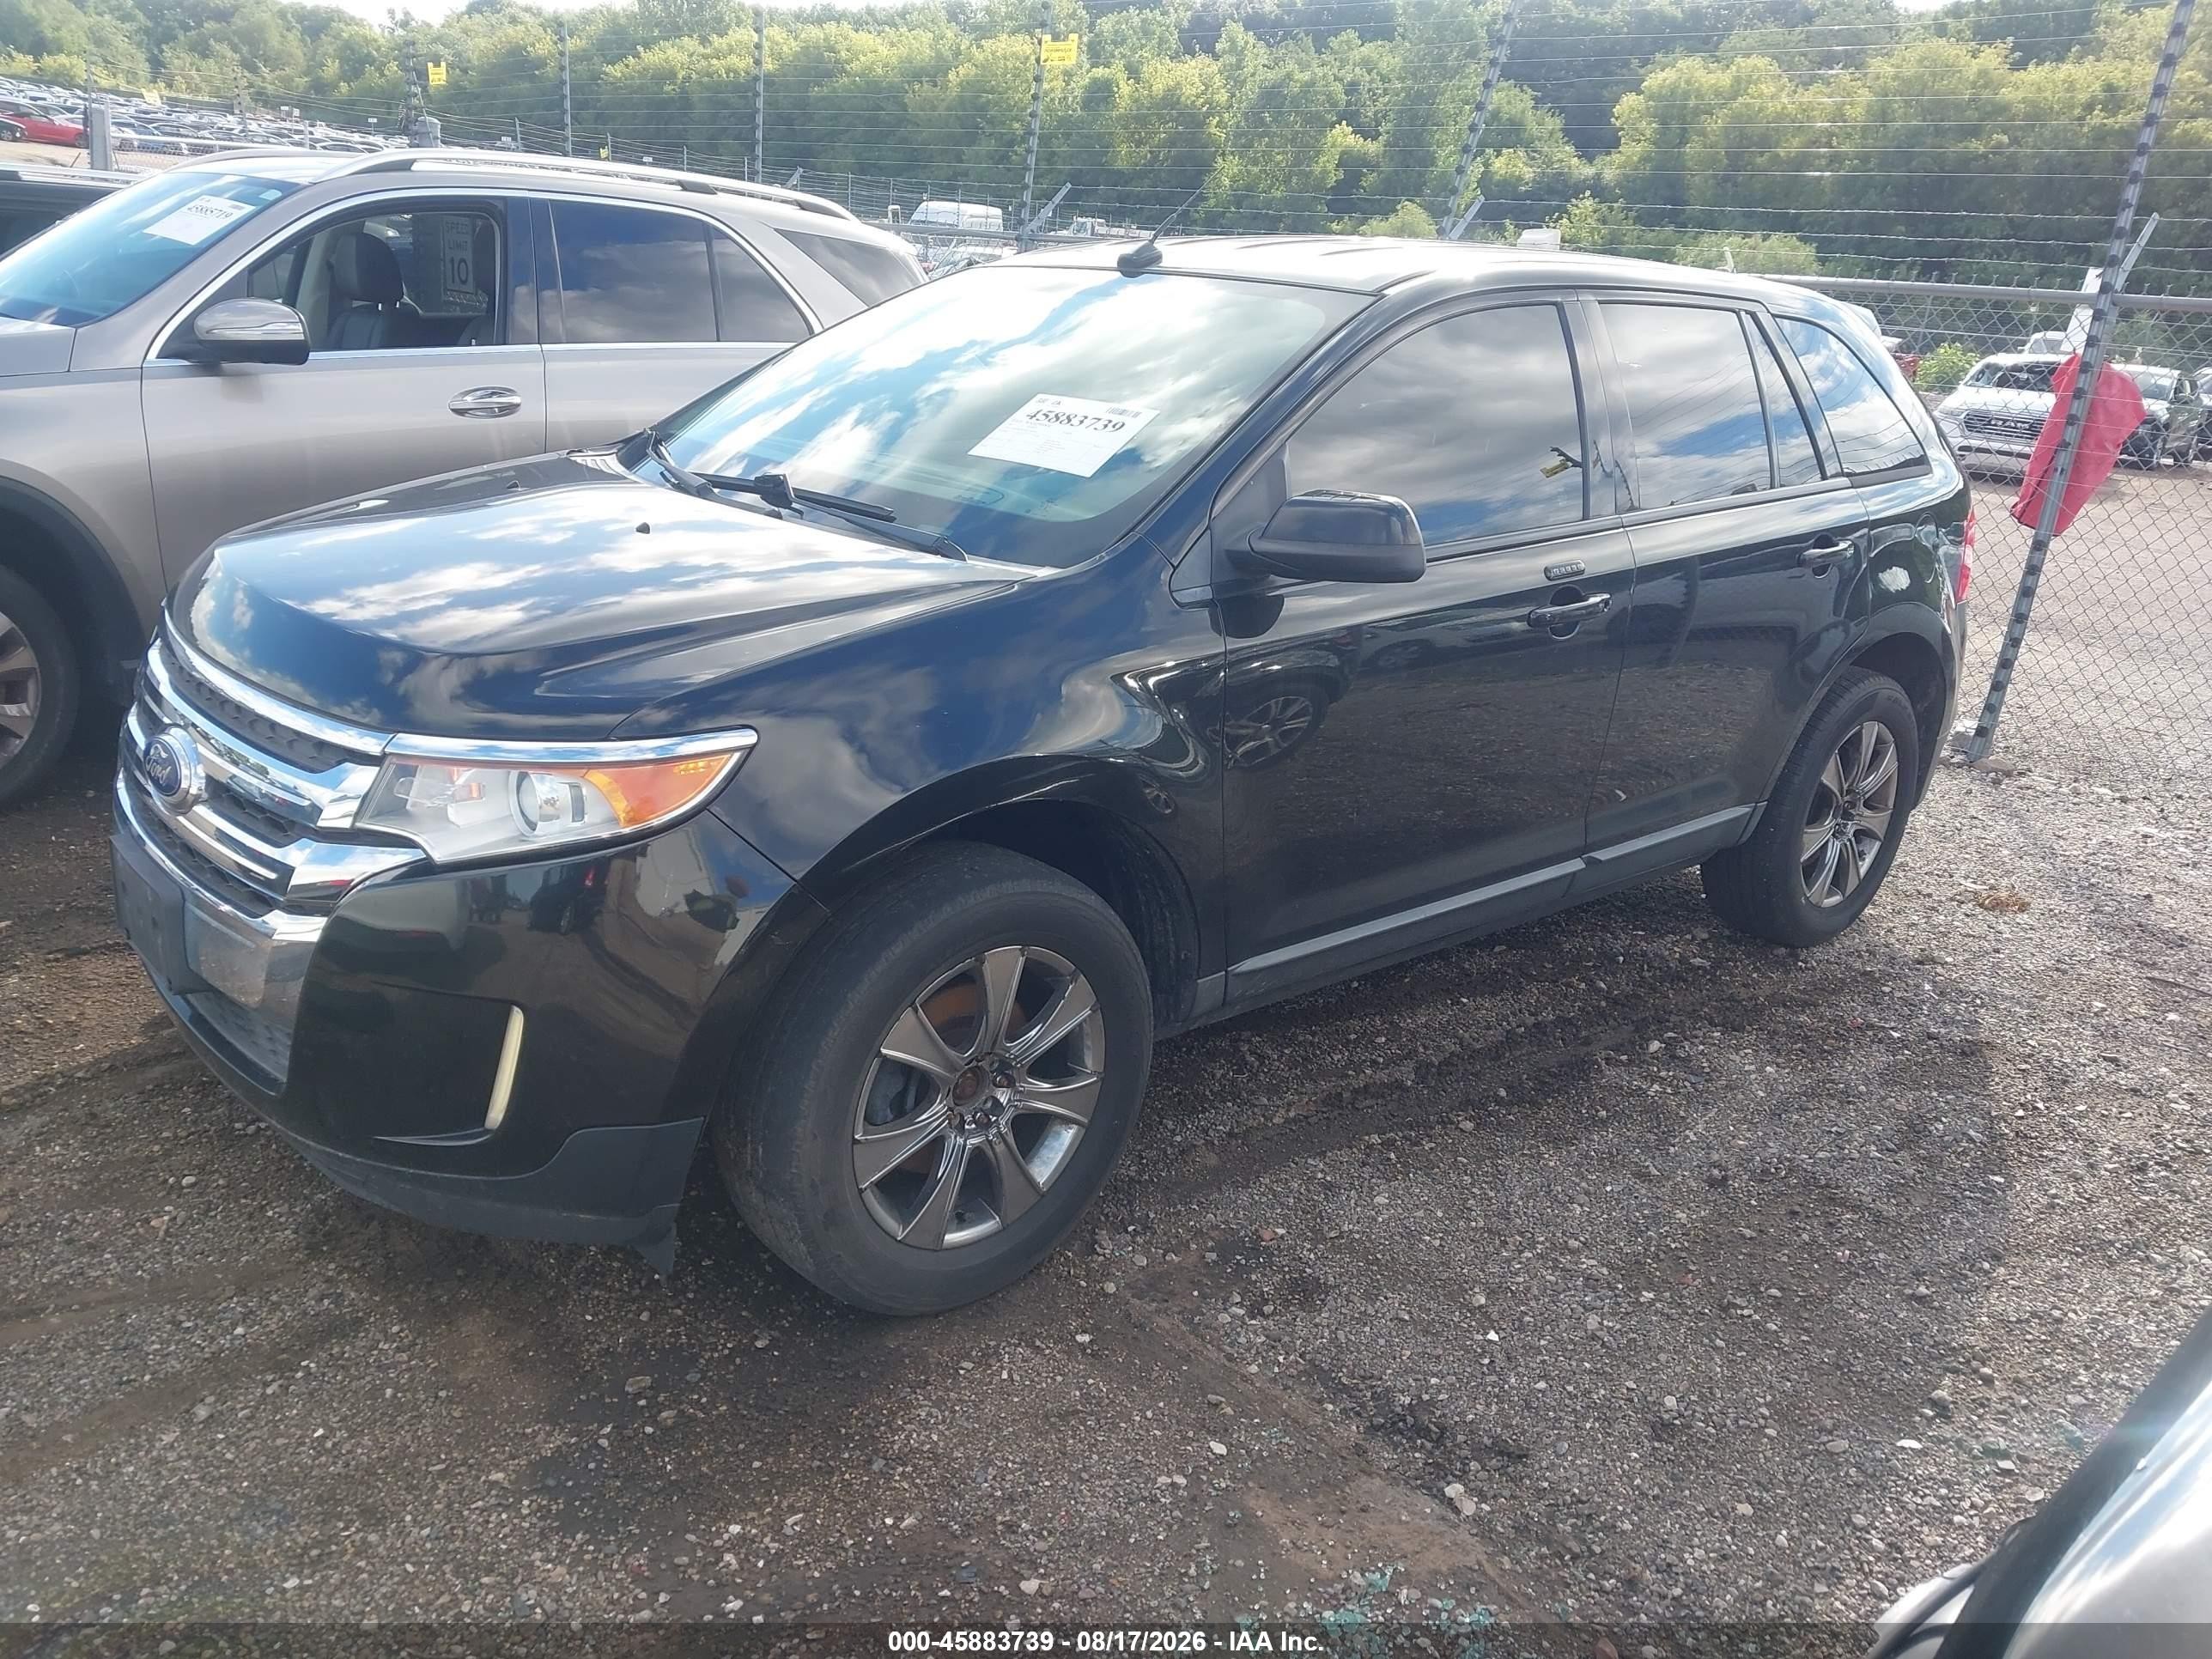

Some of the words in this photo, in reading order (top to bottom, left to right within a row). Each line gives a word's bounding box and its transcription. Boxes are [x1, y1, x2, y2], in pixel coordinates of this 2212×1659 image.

[449, 256, 469, 285] 10
[1025, 408, 1126, 433] 45883739
[1990, 418, 2030, 430] RAM
[145, 743, 173, 785] Ford
